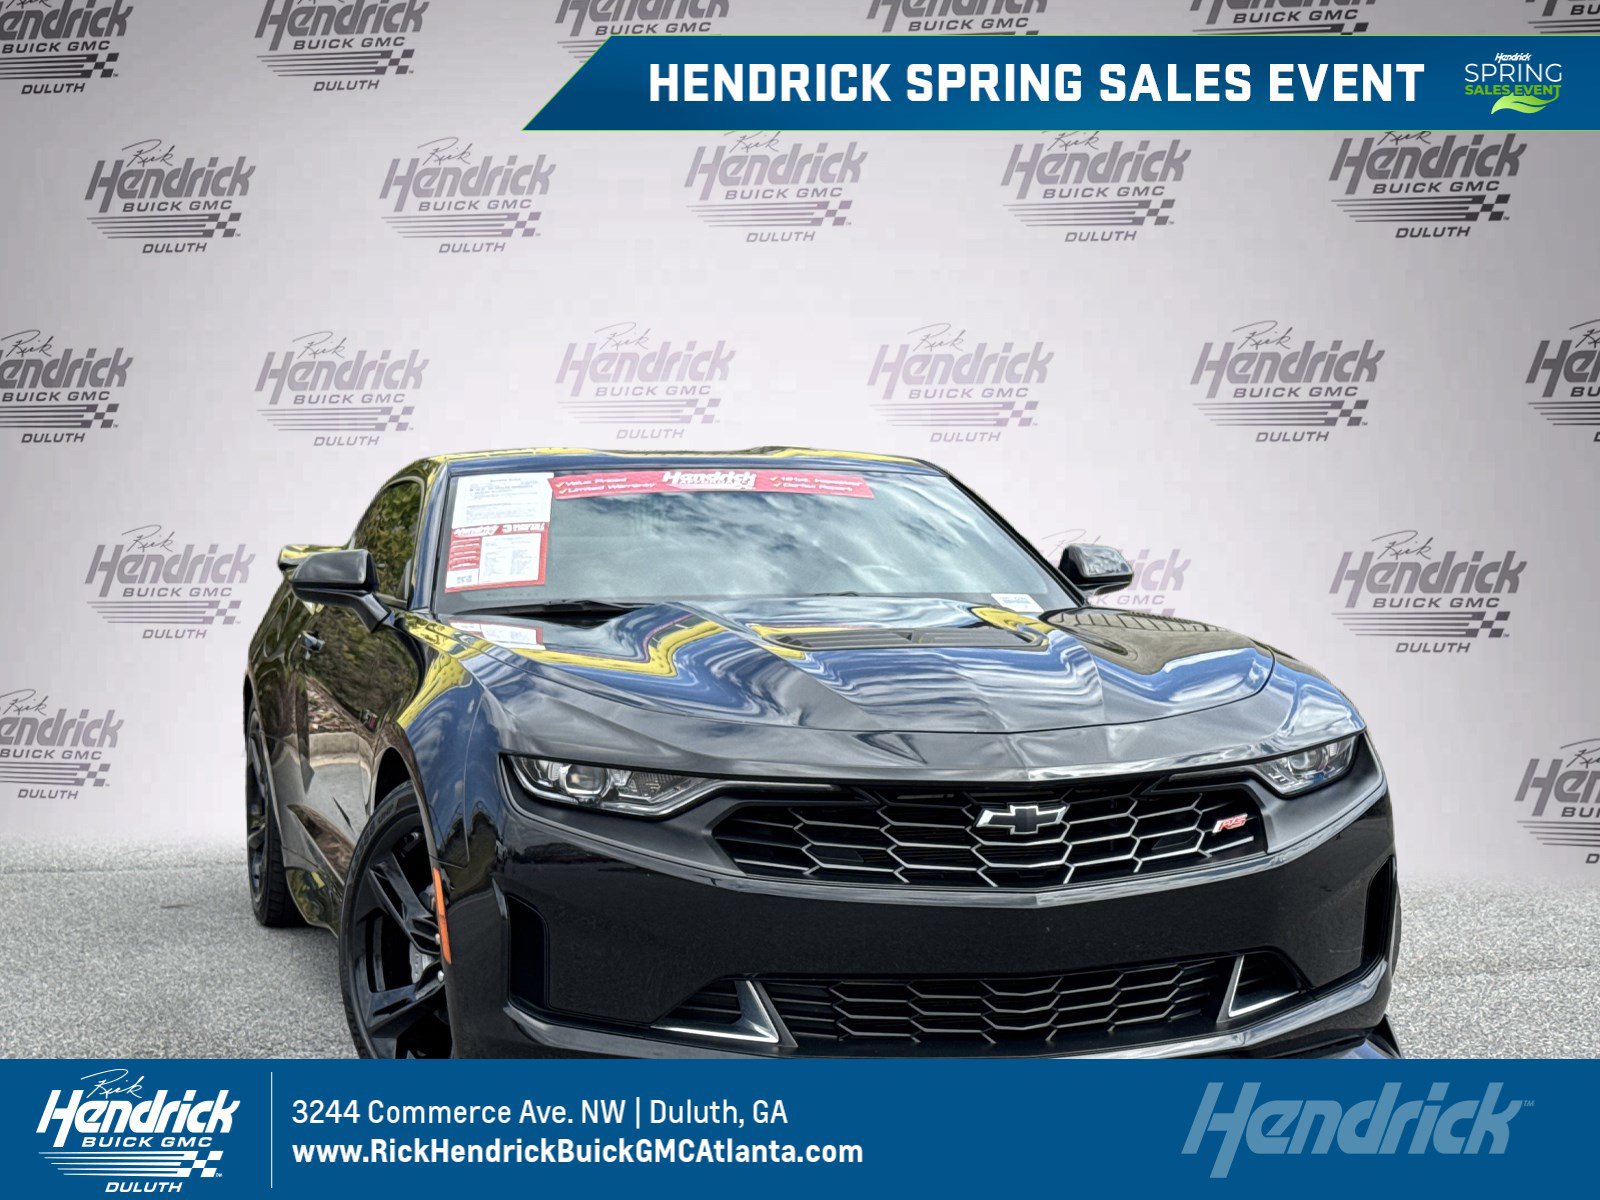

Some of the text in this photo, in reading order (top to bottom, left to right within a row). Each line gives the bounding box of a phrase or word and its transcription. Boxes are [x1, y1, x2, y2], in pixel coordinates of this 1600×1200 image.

[0, 0, 134, 40] endrick
[1233, 9, 1358, 23] BUICK GMC
[255, 0, 430, 51] Hendrick
[595, 22, 711, 36] BUICK GMC
[909, 18, 1028, 31] BUICK GMC
[2, 41, 110, 53] BUICK GMC
[293, 37, 405, 50] BUICK GMC
[21, 83, 85, 94] DULUTH
[314, 80, 379, 91] DULUTH
[1000, 139, 1191, 200] Hendrick
[1329, 133, 1527, 195] Hendrick
[684, 141, 868, 200] Hendrick
[84, 156, 256, 213] Hendrick
[379, 154, 556, 212] Hendrick
[1373, 181, 1500, 194] BUICK GMC
[725, 188, 842, 199] BUICK GMC
[1043, 186, 1165, 198] BUICK GMC
[123, 200, 232, 212] BUICK GMC
[419, 199, 531, 211] BUICK GMC
[746, 231, 815, 242] DULUTH
[1065, 231, 1137, 242] DULUTH
[1396, 226, 1471, 238] DULUTH
[143, 243, 207, 253] DULUTH
[439, 242, 505, 253] DULUTH
[0, 347, 134, 389] endrick
[555, 340, 736, 397] Hendrick
[866, 341, 1054, 400] Hendrick
[1190, 339, 1385, 398] Hendrick
[254, 348, 430, 405] Hendrick
[2, 391, 110, 402] BUICK GMC
[596, 386, 711, 396] BUICK GMC
[909, 388, 1028, 399] BUICK GMC
[1234, 386, 1358, 398] BUICK GMC
[293, 394, 405, 404] BUICK GMC
[21, 433, 85, 443] DULUTH
[616, 429, 684, 439] DULUTH
[930, 432, 1001, 442] DULUTH
[1256, 431, 1329, 442] DULUTH
[314, 436, 379, 446] DULUTH
[84, 544, 256, 597] Hendrick
[1329, 551, 1528, 608] Hendrick
[123, 588, 232, 597] BUICK GMC
[1117, 595, 1165, 605] GMC
[1373, 598, 1499, 608] BUICK GMC
[142, 629, 206, 639] DULUTH
[1396, 643, 1471, 653] DULUTH
[0, 709, 124, 748] endrick
[0, 749, 102, 760] BUICK GMC
[18, 789, 78, 799] DULUTH
[1213, 813, 1248, 832] RS
